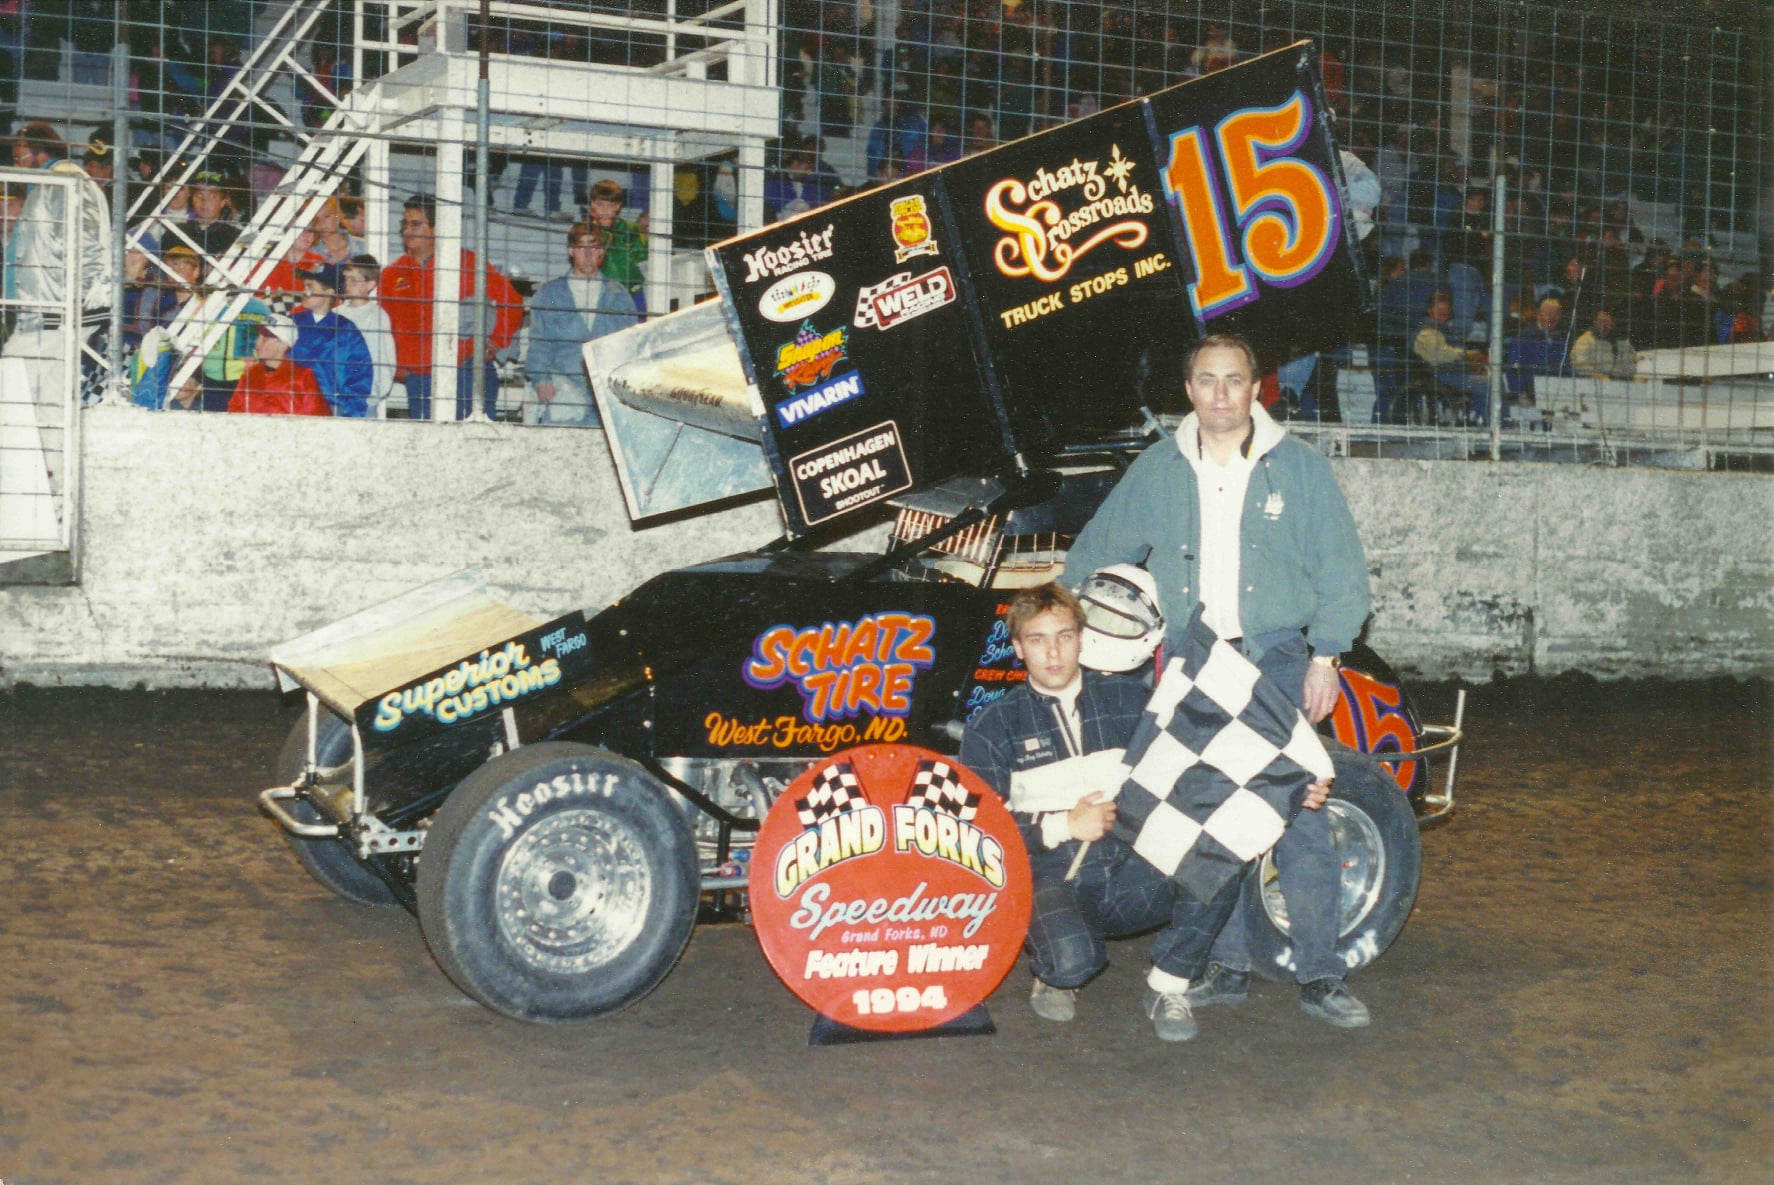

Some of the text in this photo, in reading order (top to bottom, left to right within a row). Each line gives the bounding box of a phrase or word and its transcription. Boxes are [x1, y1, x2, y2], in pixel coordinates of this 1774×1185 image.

[984, 156, 1106, 278] Schatz
[1160, 89, 1342, 321] 15
[742, 223, 834, 283] Hoosier
[1020, 185, 1154, 282] Crossroads
[773, 257, 810, 277] RACING
[1001, 252, 1171, 329] TRUCK STOPS INC.
[877, 275, 948, 317] WELD
[780, 375, 860, 423] VIVARIN
[796, 430, 896, 480] COPENHAGEN
[820, 458, 887, 499] SKOAL
[835, 485, 881, 510] SHOOTOUT
[540, 627, 566, 652] WEST
[554, 633, 587, 658] FARGO
[744, 611, 935, 690] SCHATZ
[979, 642, 1014, 665] Scha
[373, 641, 531, 732] Superior
[436, 658, 562, 724] CUSTOMS
[800, 662, 916, 722] TIRE
[974, 669, 1006, 681] CREW
[705, 711, 908, 751] West Fargo, ND.
[489, 763, 619, 841] Hoosier
[775, 804, 1006, 898] GRAND FORKS
[790, 882, 998, 940] Speedway
[841, 928, 879, 943] Grand
[929, 926, 948, 939] ND
[804, 942, 990, 980] Feature Winner
[852, 985, 947, 1015] 1994
